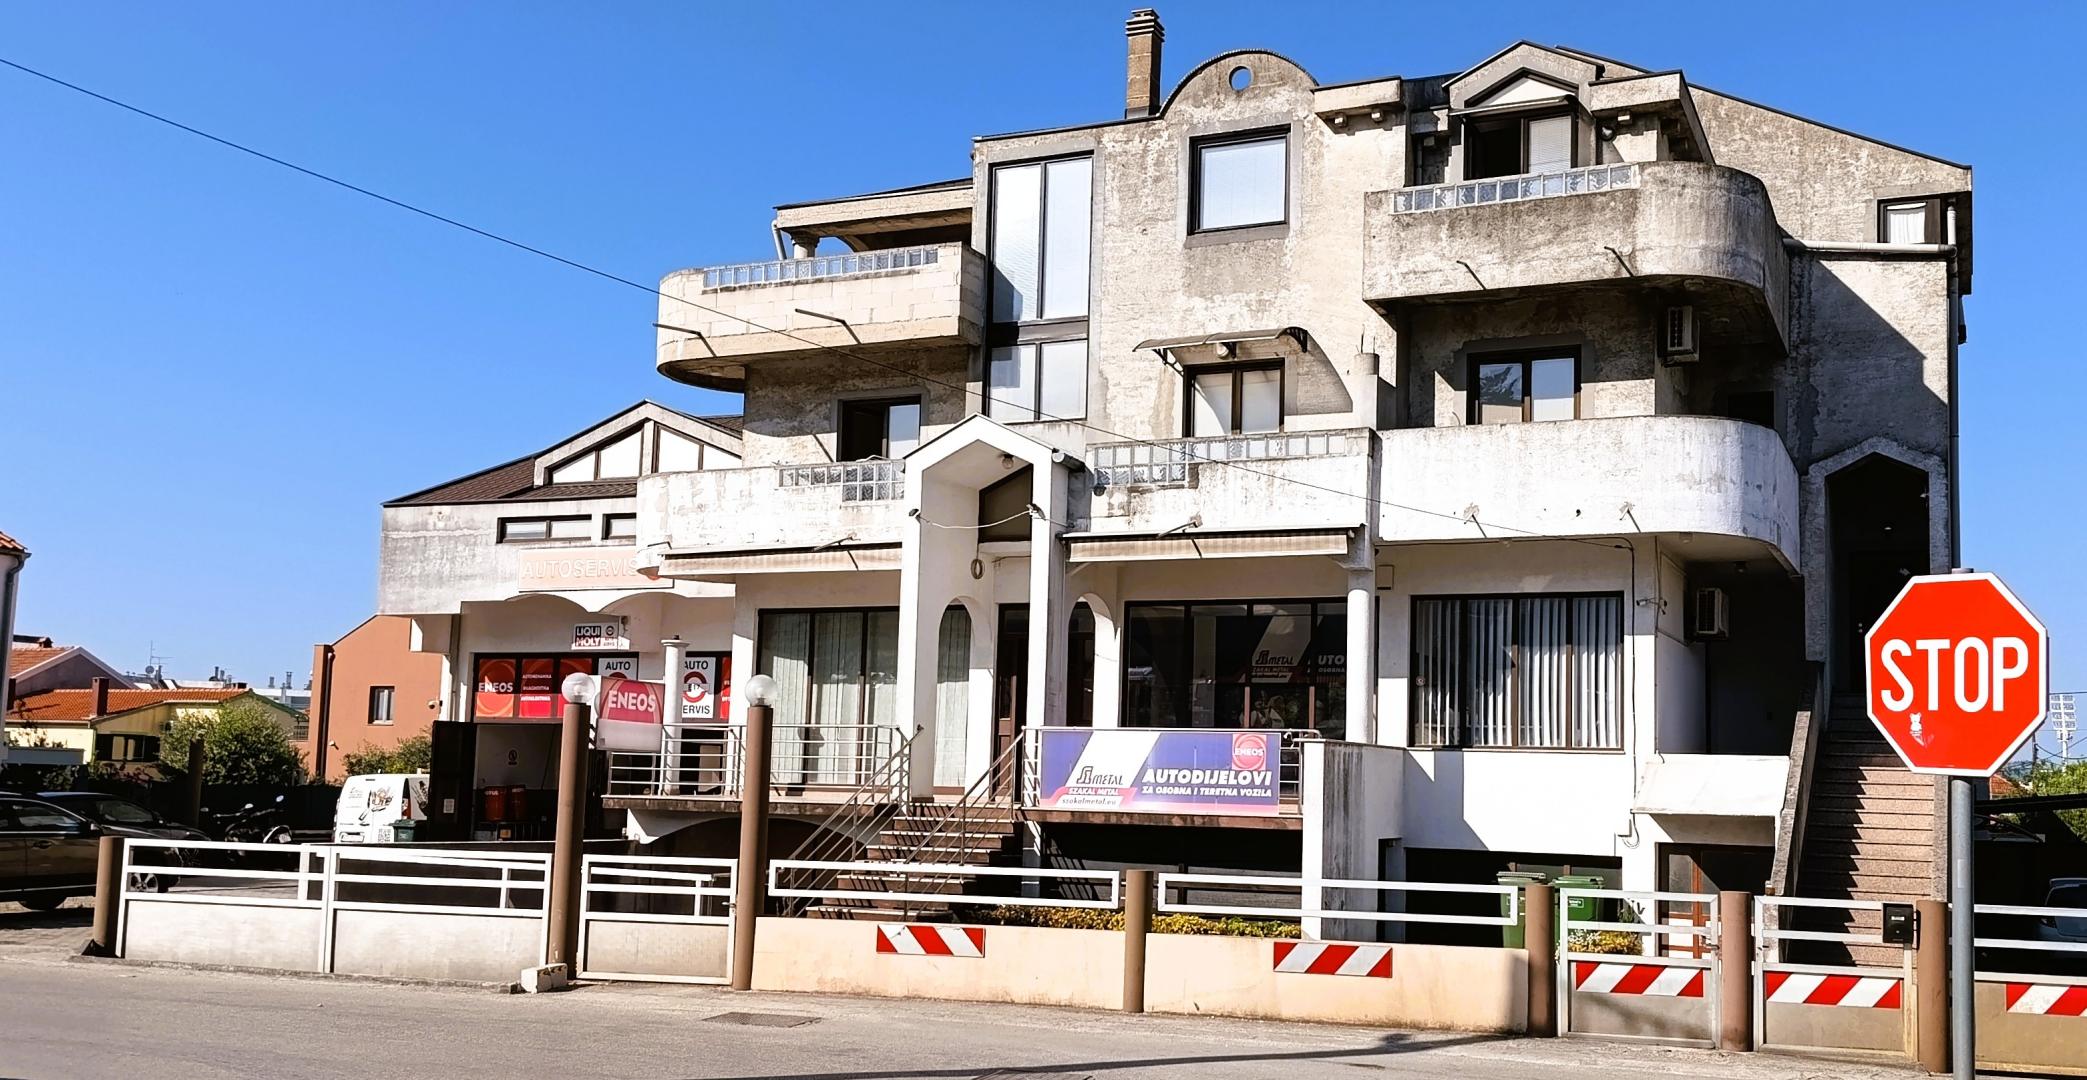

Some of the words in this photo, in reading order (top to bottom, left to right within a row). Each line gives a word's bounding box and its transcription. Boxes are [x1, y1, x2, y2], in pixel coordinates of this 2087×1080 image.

[521, 559, 637, 579] AUTOSERVIS
[576, 626, 600, 637] LIQUI
[576, 637, 600, 646] MOLY
[605, 661, 631, 670] AUTO
[1881, 636, 2029, 712] STOP
[478, 682, 513, 692] ENEOS
[608, 690, 656, 712] ENEOS
[682, 705, 710, 714] ERVIS
[1234, 747, 1264, 757] ENEOS
[1092, 774, 1123, 785] METAL
[1141, 768, 1272, 786] AUTODIJELOVI
[1068, 787, 1095, 795] SZAKAL
[1142, 786, 1154, 794] ZA
[1155, 786, 1192, 795] OSOBNA
[1199, 787, 1238, 796] TERETNA
[1240, 788, 1272, 797] VOZILA
